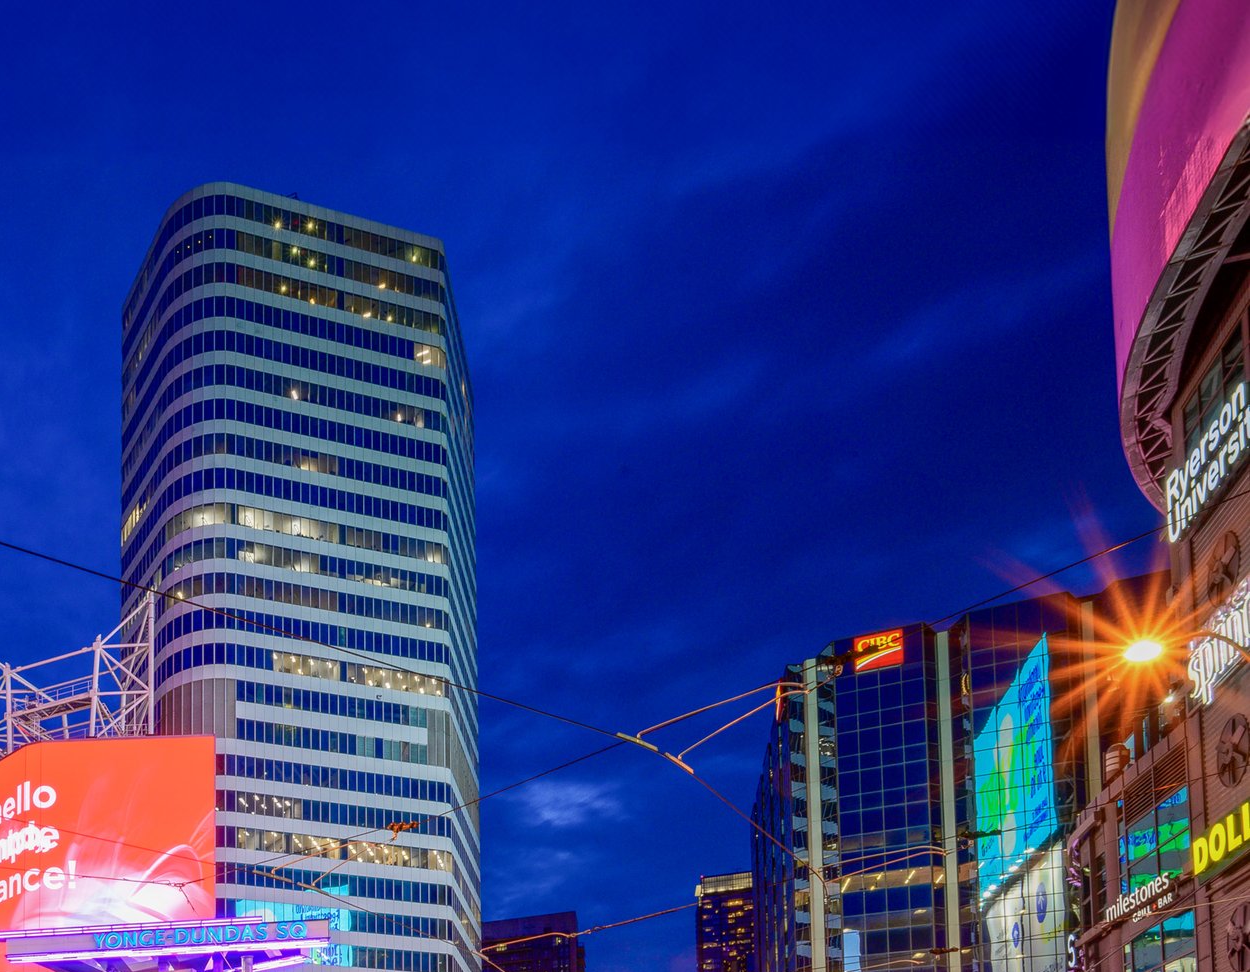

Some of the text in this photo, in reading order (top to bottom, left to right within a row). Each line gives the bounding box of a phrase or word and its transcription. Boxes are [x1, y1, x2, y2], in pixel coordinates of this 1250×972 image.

[1166, 382, 1246, 514] Ryerson
[857, 633, 900, 652] CIBC
[1106, 871, 1170, 923] milestones
[1158, 893, 1173, 909] BAR
[94, 921, 308, 949] YONGE-DUNDAS SQ
